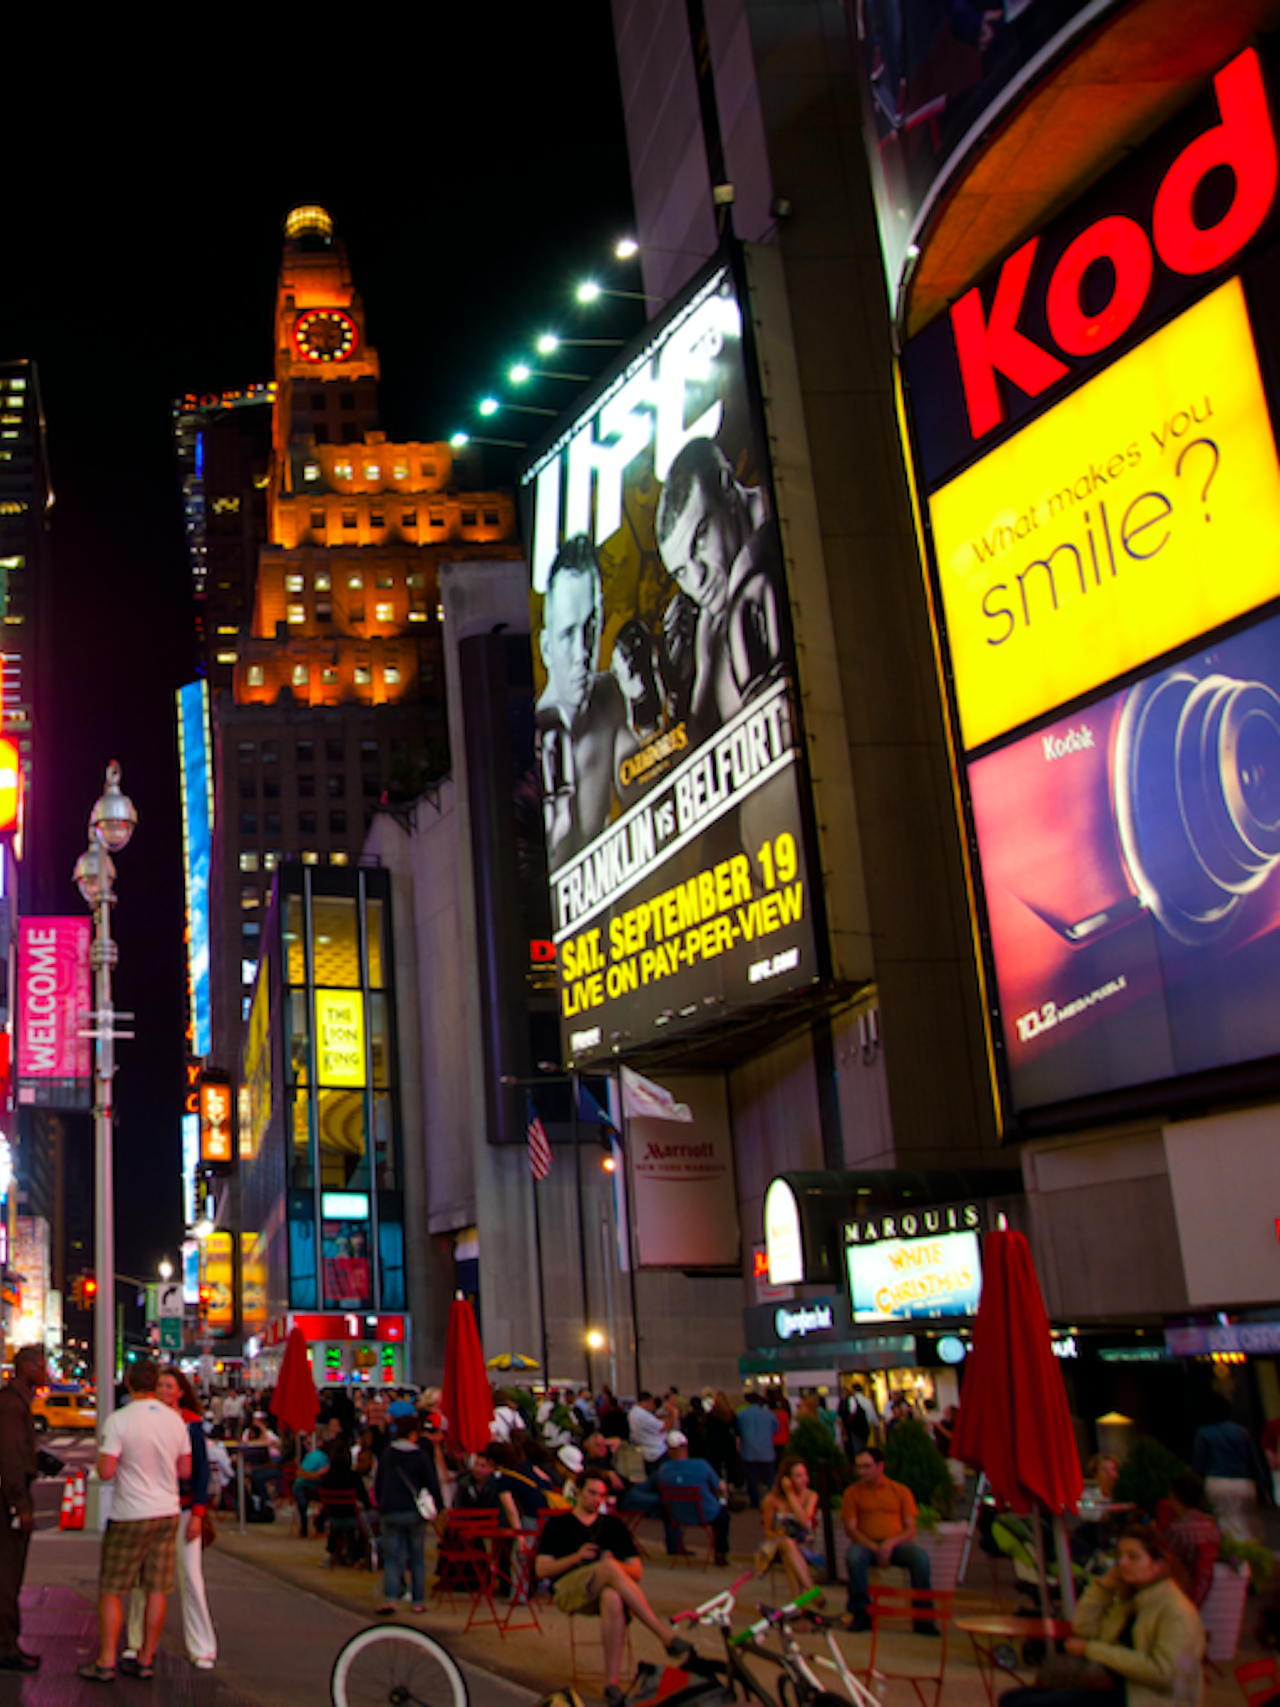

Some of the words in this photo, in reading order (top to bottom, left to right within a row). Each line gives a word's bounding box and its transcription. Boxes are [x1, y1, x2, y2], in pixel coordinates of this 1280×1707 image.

[949, 46, 1279, 440] Kod
[972, 505, 1038, 564] What
[1047, 442, 1142, 518] makes
[1150, 396, 1213, 455] you
[982, 437, 1220, 646] smile?
[1041, 723, 1095, 762] Kodak
[556, 804, 657, 930] FRANKLIN
[673, 693, 787, 834] BELFORT
[561, 926, 606, 982] SAT.
[609, 852, 753, 968] SEPTEMBER
[757, 831, 799, 891] 19
[561, 974, 605, 1019] LIVE
[606, 961, 639, 1001] ON
[641, 881, 803, 985] PAY-PER-VIEW
[27, 926, 57, 1072] WELCOME
[326, 1007, 352, 1023] THE
[322, 1025, 358, 1046] LION
[1016, 1001, 1060, 1042] 10.2
[323, 1051, 360, 1072] KING
[635, 1163, 655, 1171] NEW
[658, 1163, 681, 1171] YORK
[642, 1142, 714, 1160] Marriott
[845, 1205, 980, 1243] MARQUIS
[888, 1242, 943, 1271] WHITE
[875, 1263, 973, 1315] CHRISTMAS
